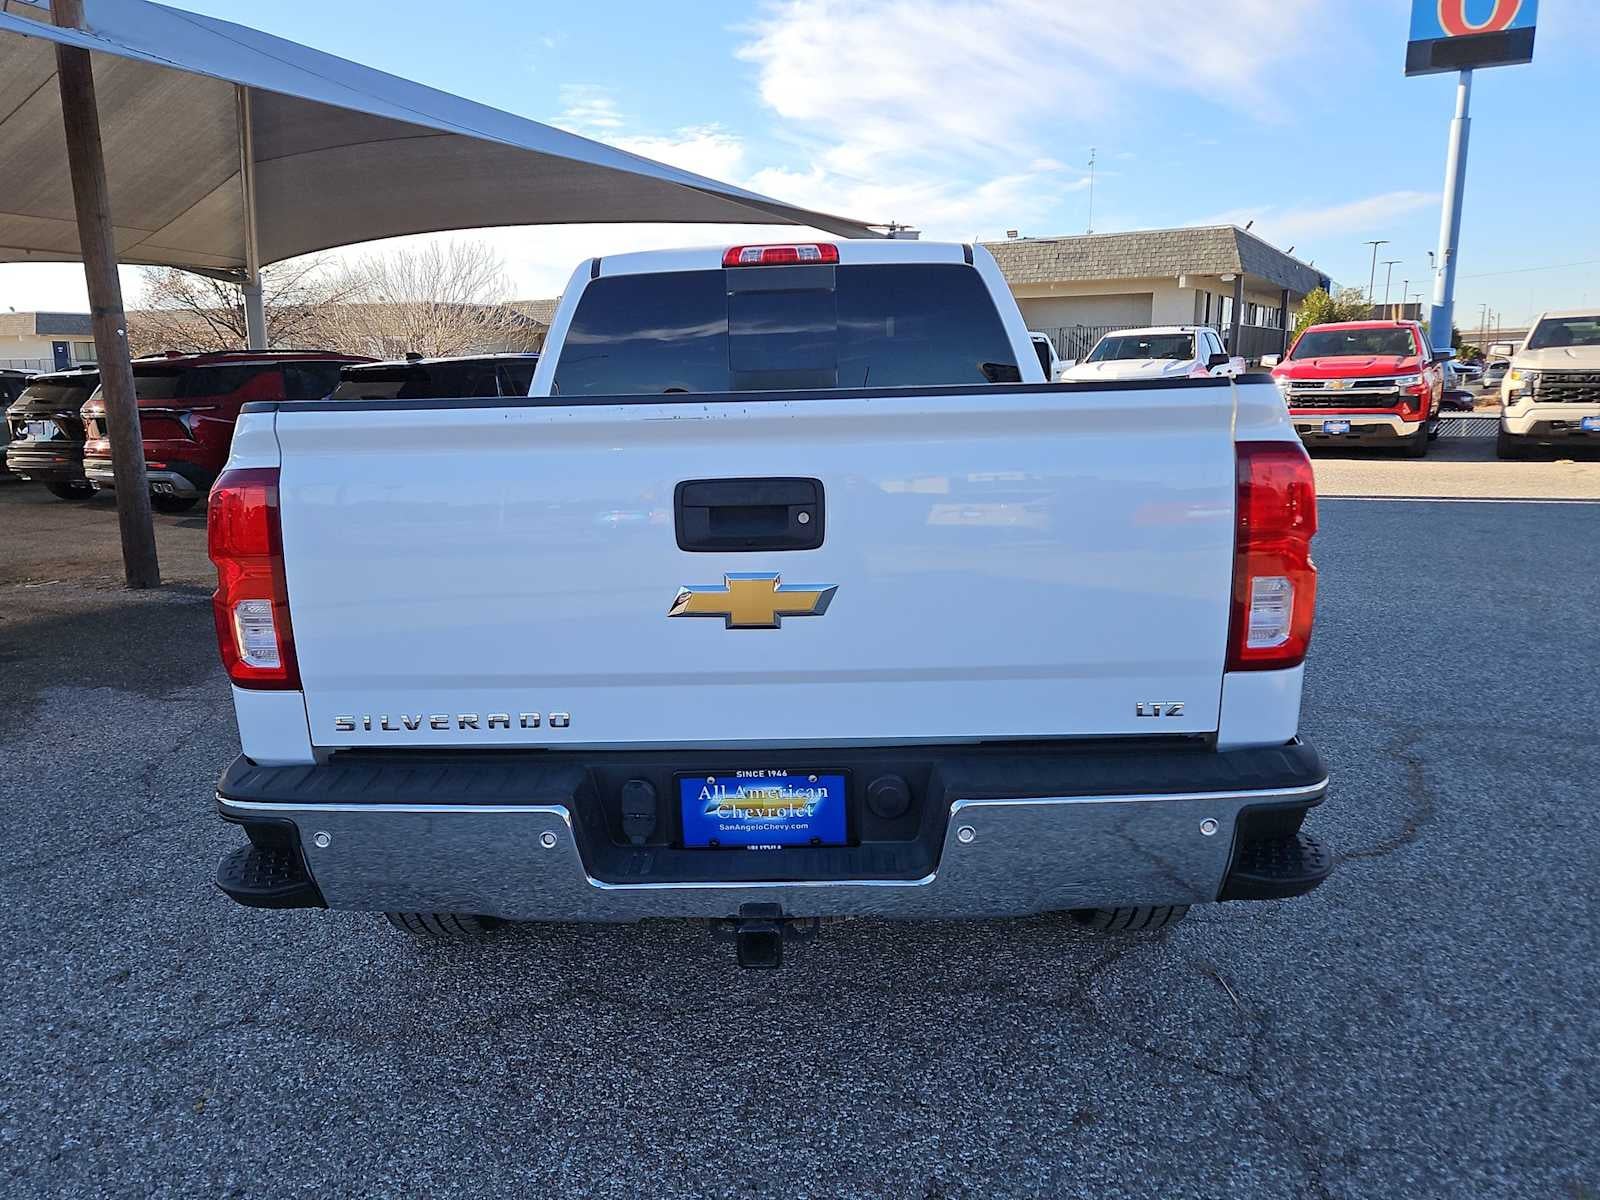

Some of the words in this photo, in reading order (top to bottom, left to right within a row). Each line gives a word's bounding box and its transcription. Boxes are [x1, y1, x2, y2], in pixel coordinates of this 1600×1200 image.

[1136, 701, 1185, 717] LTZ
[335, 711, 571, 732] SILVERADO
[736, 770, 765, 778] SINCE
[698, 785, 726, 800] All
[735, 784, 829, 799] American
[717, 804, 814, 819] Chevrolet
[719, 823, 809, 832] SanAngeloChevy.com
